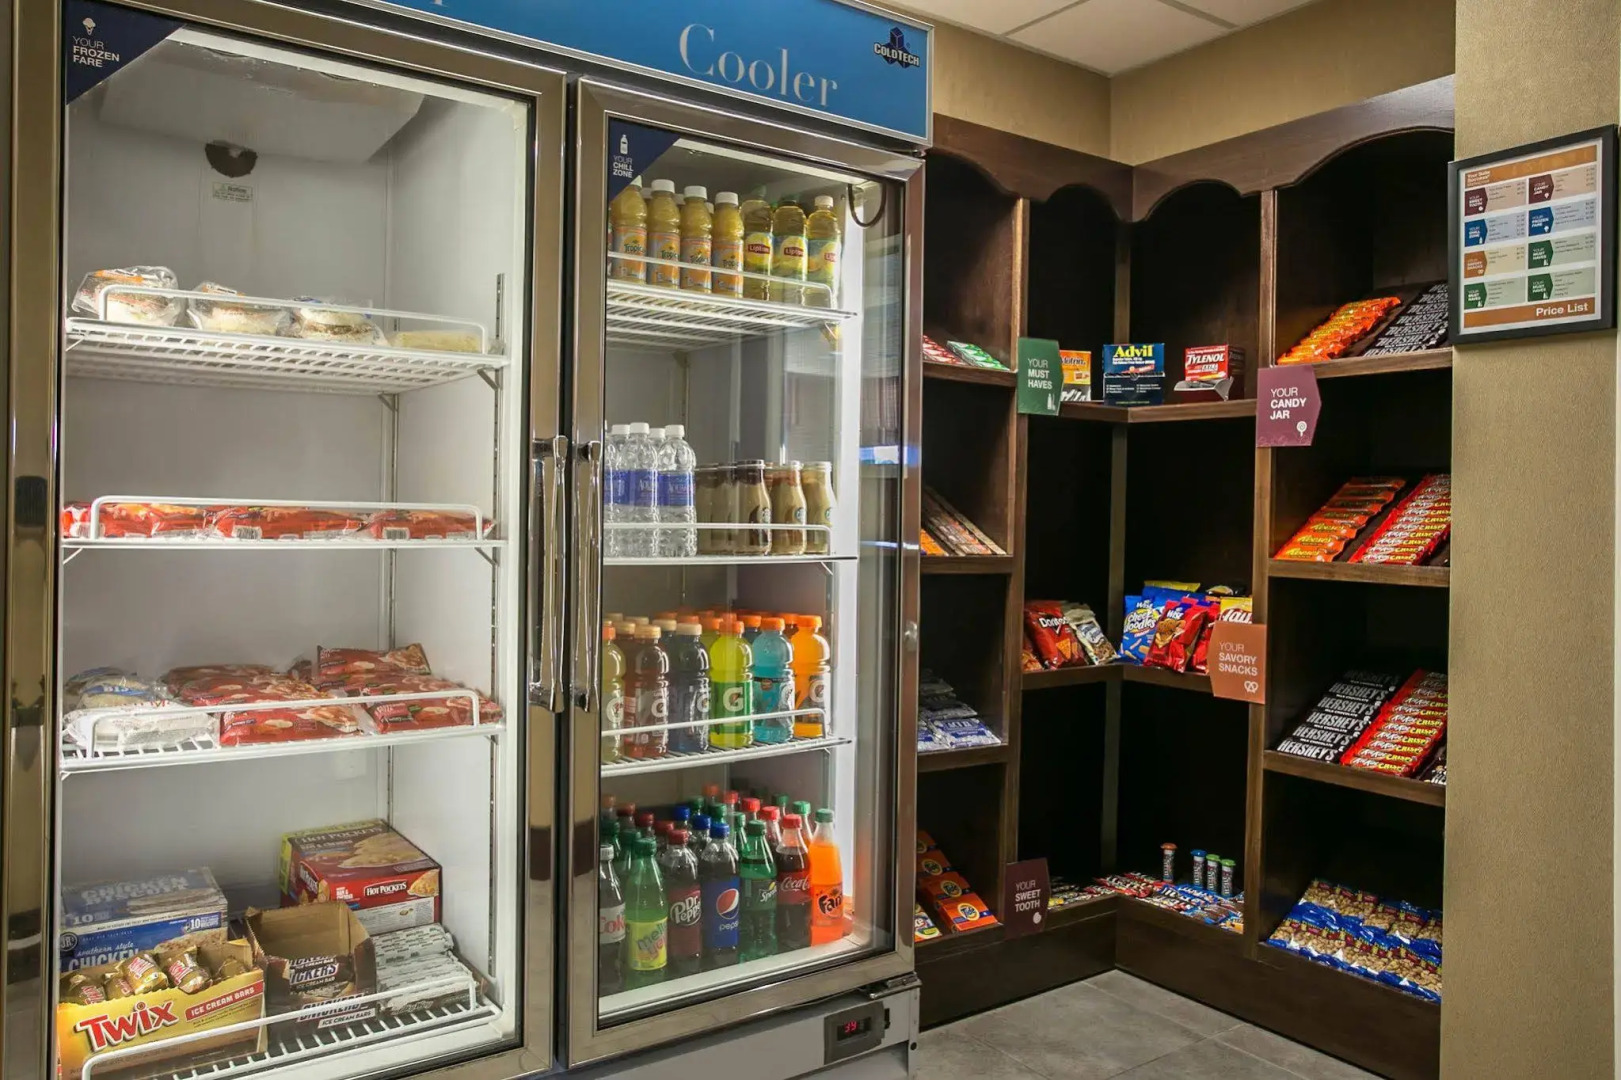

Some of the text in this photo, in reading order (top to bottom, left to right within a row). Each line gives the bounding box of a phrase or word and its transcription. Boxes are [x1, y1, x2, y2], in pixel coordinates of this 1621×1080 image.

[73, 36, 104, 49] YOUR
[73, 46, 120, 62] FROZEN
[73, 55, 103, 67] FARE
[679, 23, 838, 108] Cooler
[613, 155, 633, 165] YOUR
[613, 162, 634, 171] CHILL
[613, 169, 633, 178] ZONE
[1536, 302, 1589, 317] Price List
[1113, 345, 1154, 357] Advil
[1028, 358, 1049, 368] YOUR
[1185, 353, 1225, 367] TYLENOL
[1028, 368, 1050, 379] MUST
[1028, 379, 1053, 389] HAVES
[1270, 387, 1298, 397] YOUR
[1270, 397, 1307, 409] CANDY
[1270, 410, 1290, 420] JAR
[1219, 642, 1245, 653] YOUR
[1219, 653, 1257, 665] SAVORY
[1219, 663, 1258, 677] SNACKS
[723, 686, 744, 712] G
[366, 882, 407, 896] HOT POCKETS
[1015, 880, 1036, 891] YOUR
[1015, 889, 1041, 901] SWEET
[1015, 900, 1041, 912] TOOTH
[190, 1006, 205, 1016] ICE
[206, 996, 234, 1010] CREAM
[234, 987, 255, 1000] BARS
